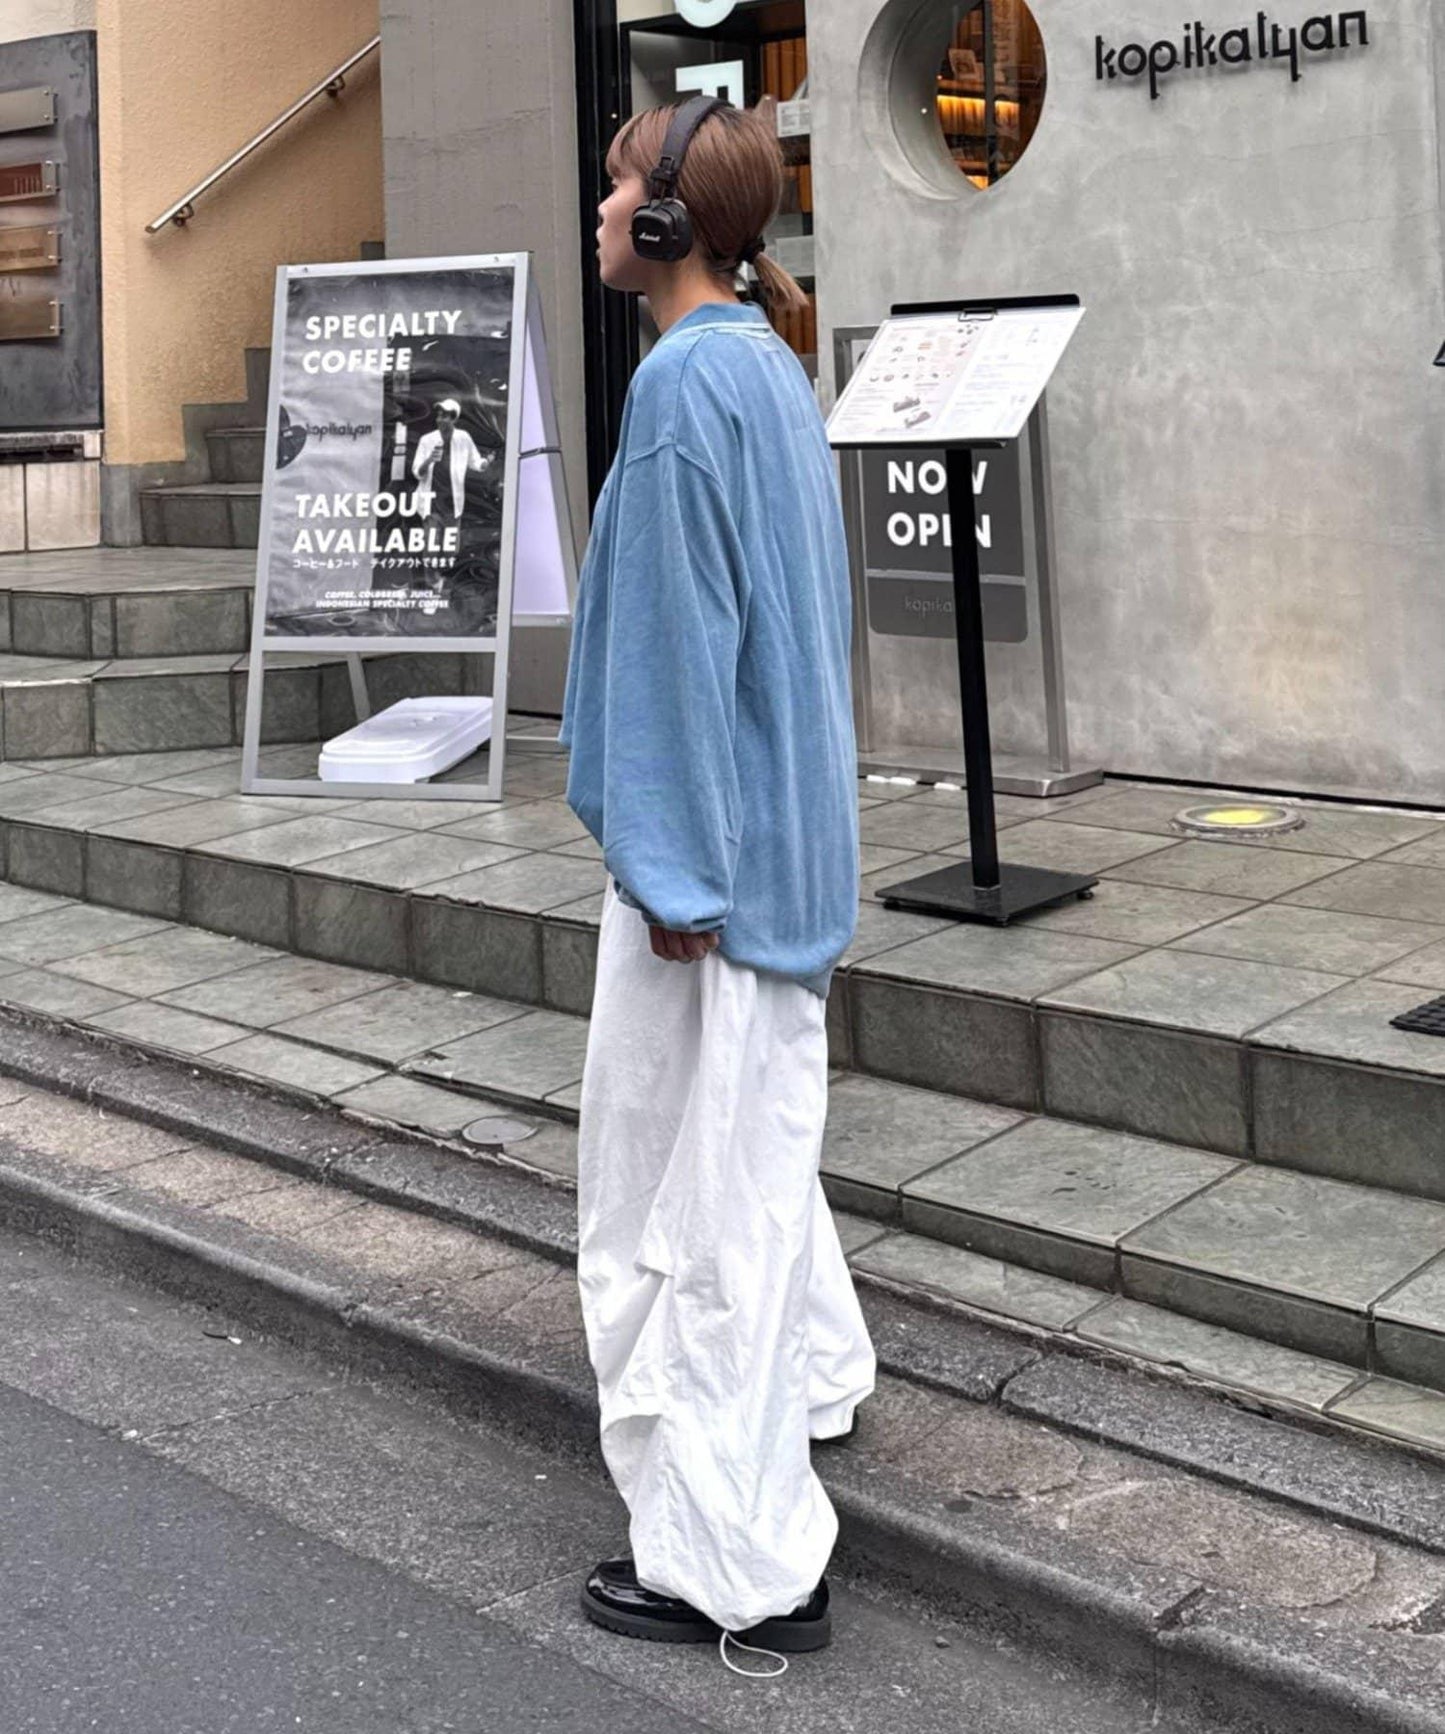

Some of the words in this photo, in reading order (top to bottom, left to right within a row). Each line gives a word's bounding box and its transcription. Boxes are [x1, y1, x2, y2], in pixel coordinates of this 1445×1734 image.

[1095, 10, 1369, 100] kopikalyan
[305, 310, 462, 341] SPECIALTY
[302, 347, 413, 374] COFFEE
[295, 491, 437, 519] TAKEOUT
[291, 527, 459, 554] AVAILABLE
